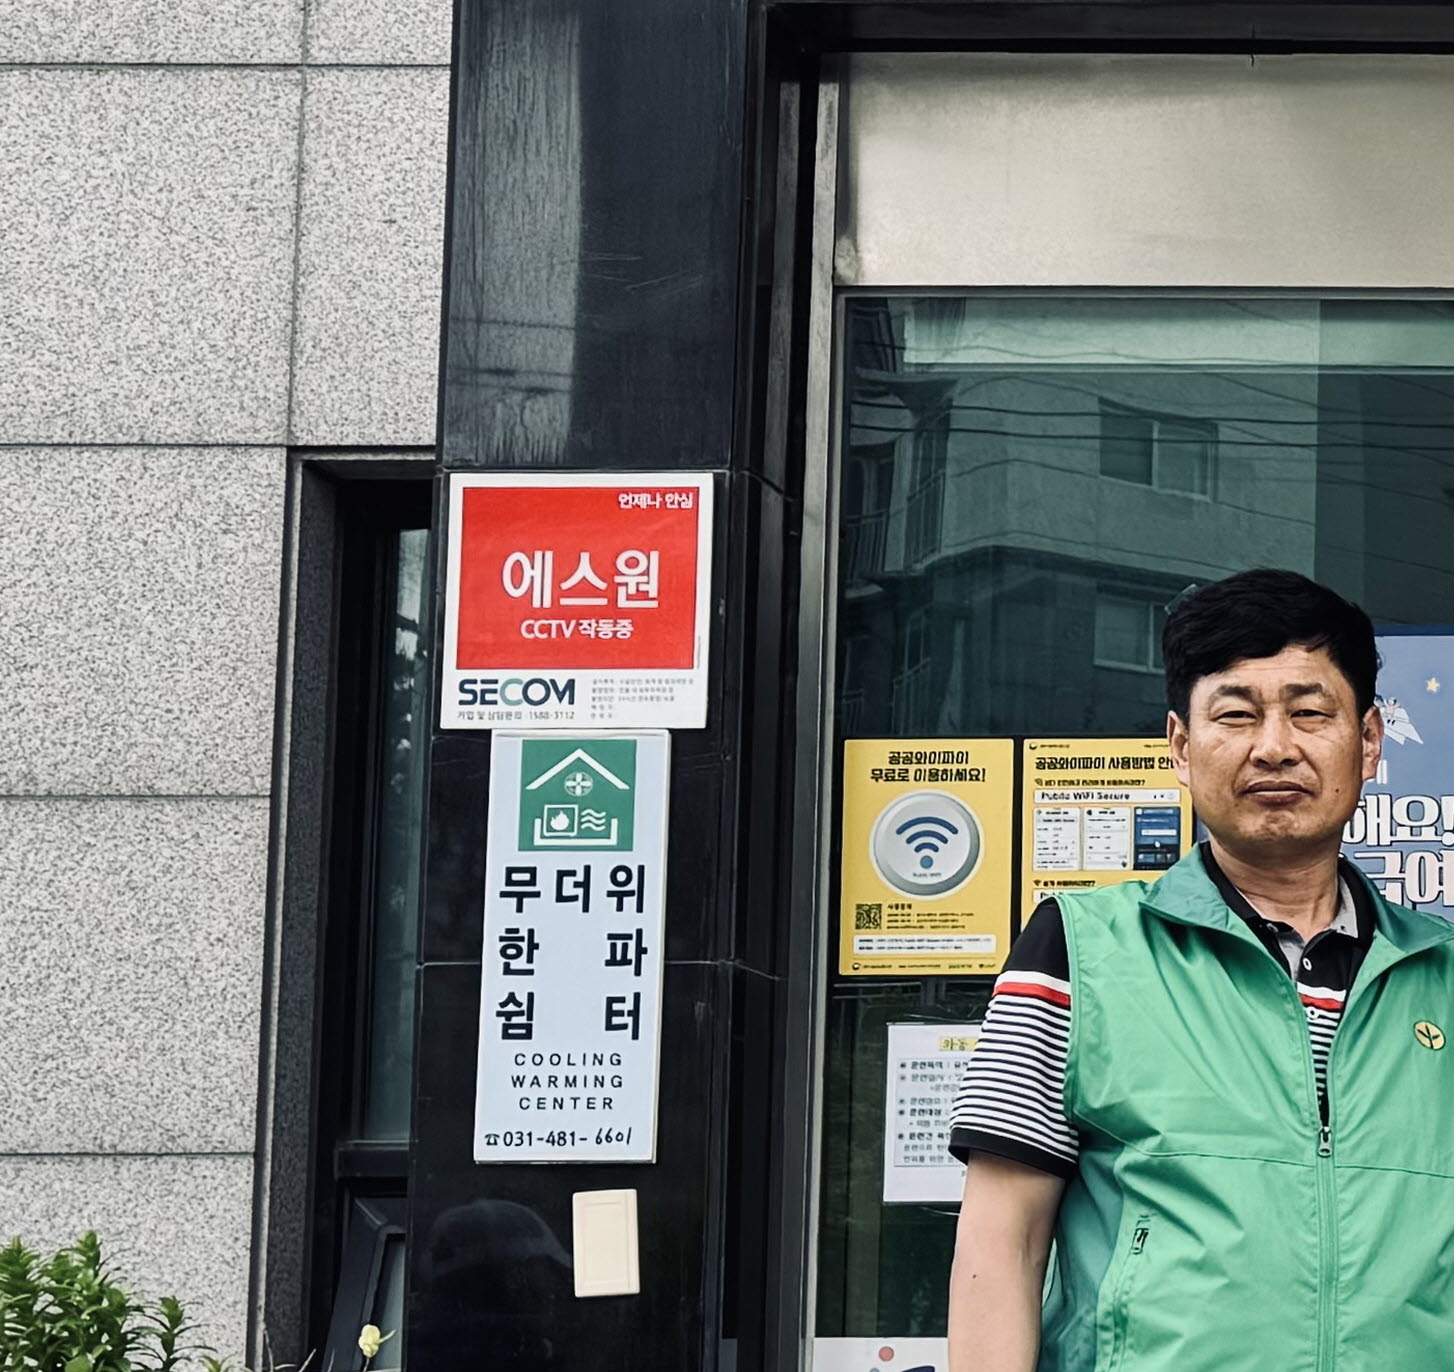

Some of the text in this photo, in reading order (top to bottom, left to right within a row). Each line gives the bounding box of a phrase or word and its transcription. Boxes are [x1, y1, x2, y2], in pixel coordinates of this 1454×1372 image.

[502, 549, 660, 609] 에스원
[520, 619, 577, 639] CCTV
[458, 677, 576, 707] SECOM
[870, 768, 910, 783] 무료로
[499, 864, 646, 914] 무더위
[514, 1052, 622, 1067] COOLING
[511, 1074, 623, 1089] WARMING
[518, 1096, 613, 1111] CENTER
